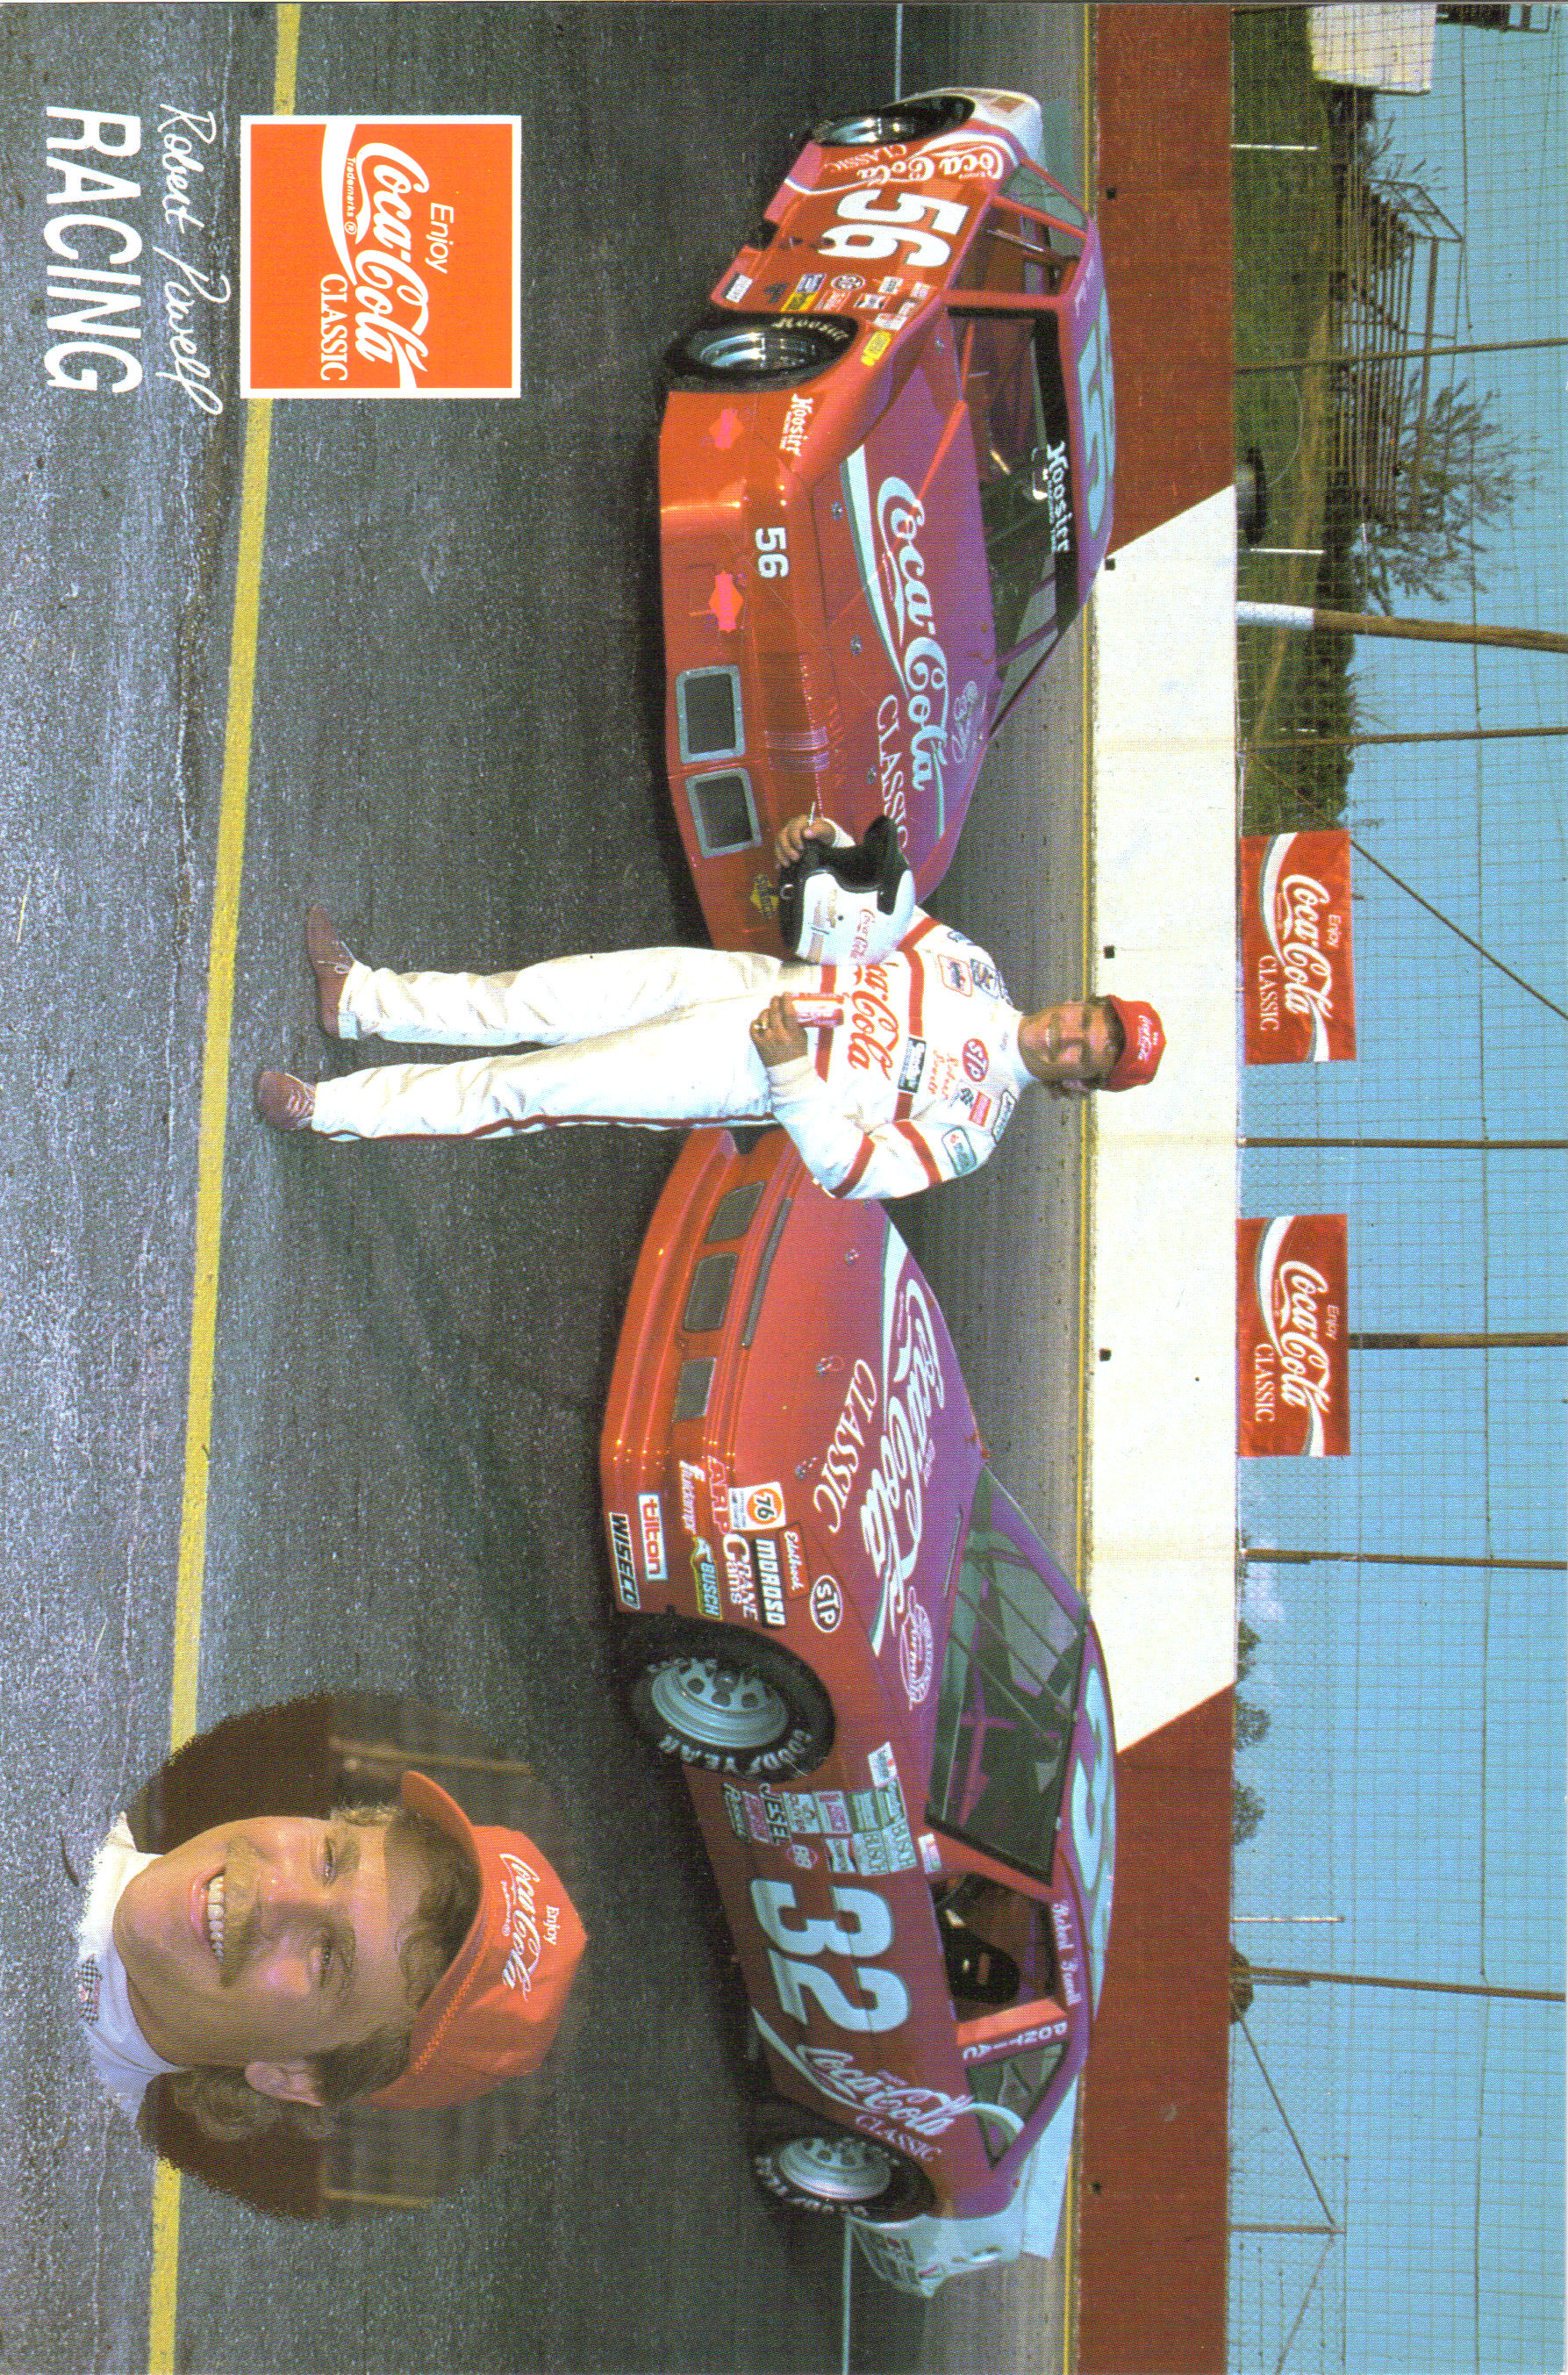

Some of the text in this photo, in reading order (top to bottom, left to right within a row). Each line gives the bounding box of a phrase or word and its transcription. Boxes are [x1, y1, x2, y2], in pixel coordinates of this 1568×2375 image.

[816, 189, 970, 267] 56
[785, 393, 814, 457] Hoosier
[1045, 441, 1074, 554] Hoosier
[755, 527, 789, 579] 56
[877, 475, 950, 792] Coca-Cola
[1281, 874, 1333, 1015] Coca-Cola
[1326, 915, 1342, 949] Enjoy
[1258, 955, 1281, 1031] CLASSIC
[965, 1042, 987, 1079] STP
[1280, 1260, 1331, 1410] Coca-Cola
[1325, 1305, 1342, 1341] Enjoy
[1255, 1344, 1276, 1423] CLASSIC
[813, 1359, 877, 1533] CLASSIC
[861, 1279, 944, 1638] Coca-Cola
[707, 1455, 733, 1536] ARP
[755, 1494, 776, 1520] 76
[611, 1514, 638, 1608] WISECO
[641, 1498, 663, 1575] tilton
[784, 1531, 803, 1591] Edelbrock
[700, 1562, 720, 1616] BUSCH
[755, 1539, 785, 1626] MOROSO
[814, 1583, 841, 1625] STP
[759, 1783, 790, 1845] JESEL
[893, 1824, 913, 1869] BUSCH
[863, 1834, 886, 1874] BUSCH
[499, 1852, 541, 2002] Coca-Cola
[543, 1905, 560, 1945] Enjoy
[751, 1879, 912, 2032] 32
[961, 2020, 1068, 2061] PONTIAC
[795, 2044, 974, 2136] Coca-Cola
[855, 2114, 942, 2162] CLASSIC
